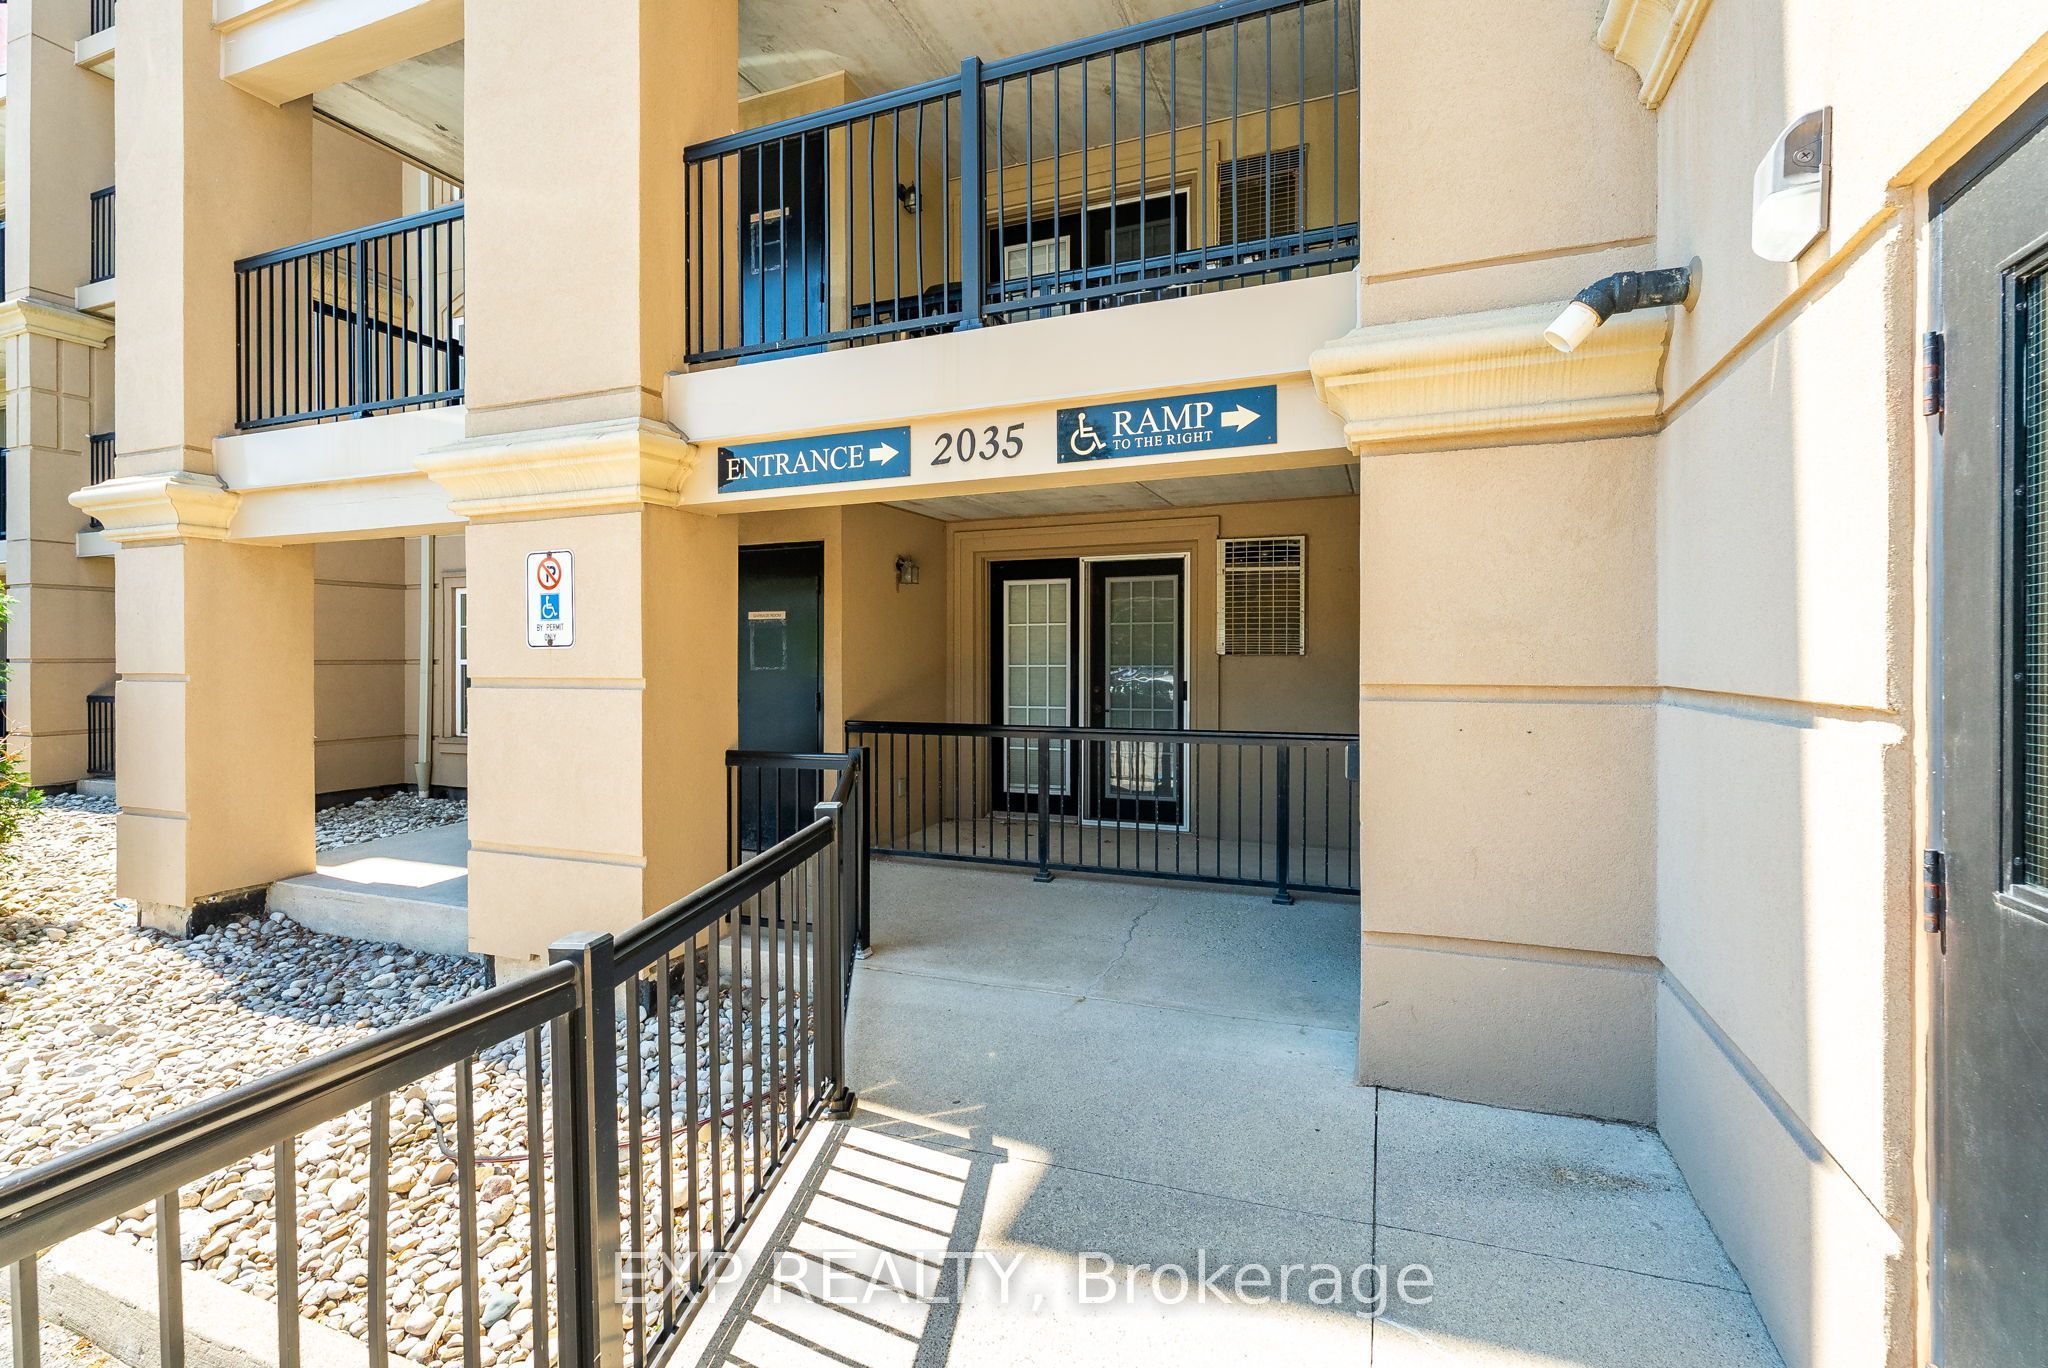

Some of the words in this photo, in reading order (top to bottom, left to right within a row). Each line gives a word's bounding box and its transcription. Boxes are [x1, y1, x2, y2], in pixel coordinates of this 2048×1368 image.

[1112, 402, 1214, 437] RAMP
[930, 422, 1025, 466] 2035
[1113, 439, 1131, 450] TO
[1134, 435, 1163, 448] THE
[1166, 430, 1214, 446] RIGHT
[726, 444, 865, 481] ENTRANCE
[546, 623, 564, 631] PERMIT
